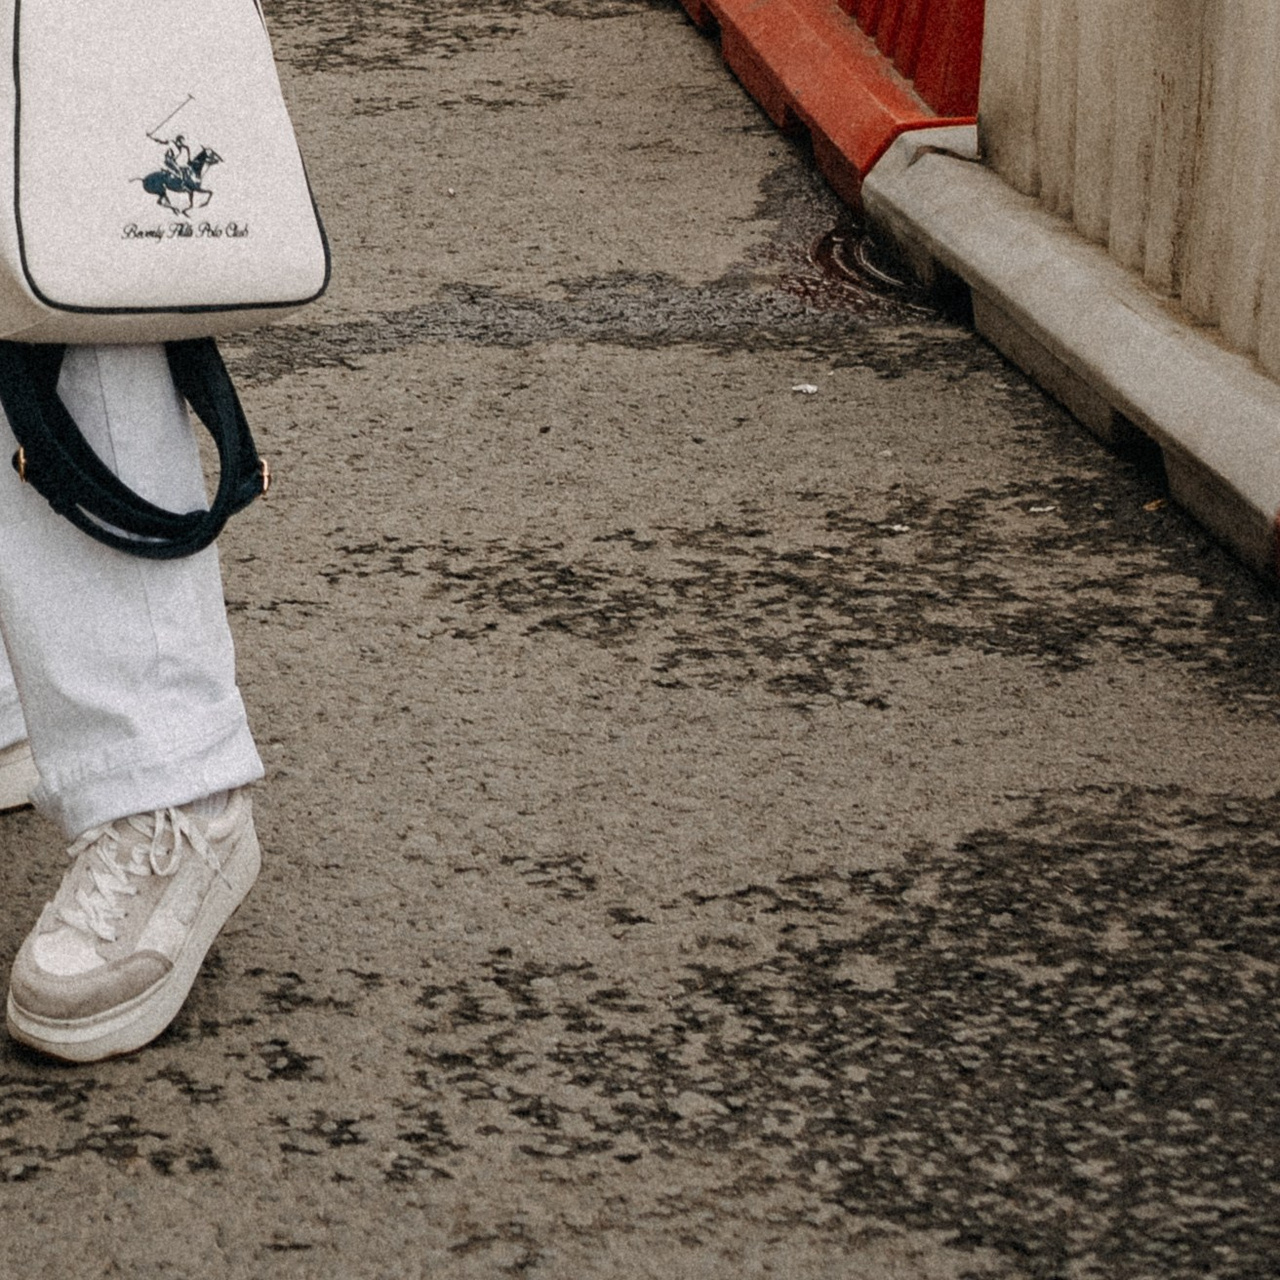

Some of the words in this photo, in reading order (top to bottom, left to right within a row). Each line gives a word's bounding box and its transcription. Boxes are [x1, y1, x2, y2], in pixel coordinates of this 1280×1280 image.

[121, 222, 165, 244] Beverly
[167, 221, 194, 239] Hills
[195, 221, 223, 239] Polo
[225, 221, 250, 238] Club
